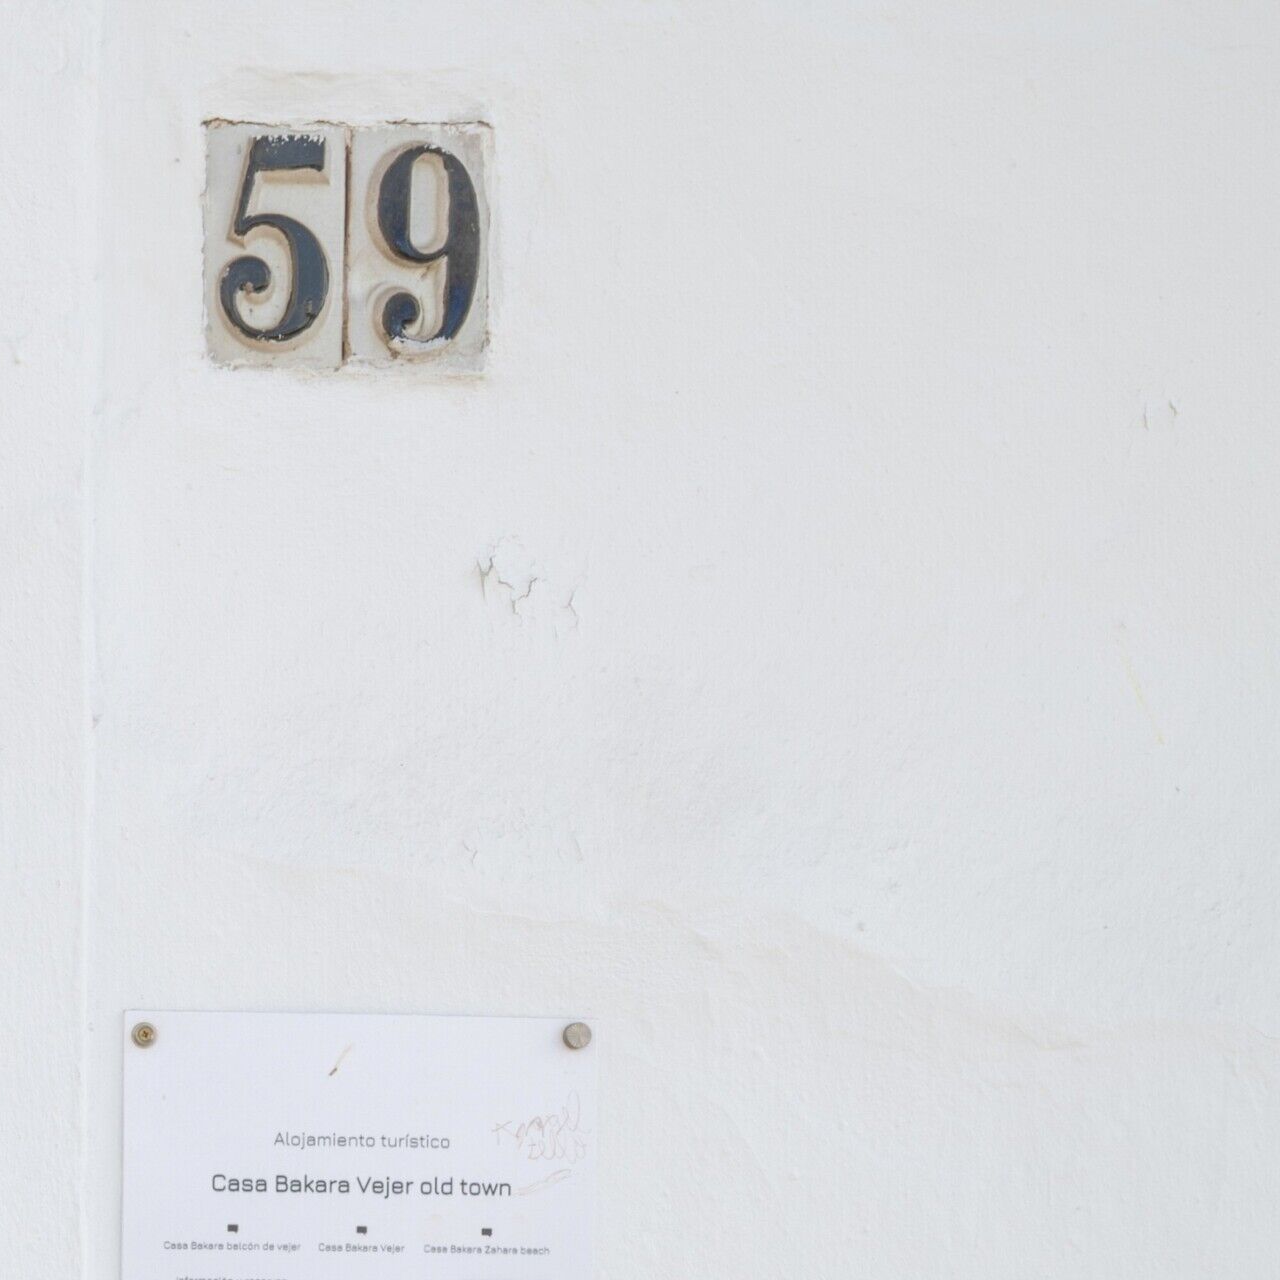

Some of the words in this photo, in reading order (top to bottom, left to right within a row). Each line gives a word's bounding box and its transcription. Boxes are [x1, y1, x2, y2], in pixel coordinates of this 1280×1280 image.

[219, 134, 481, 345] 59
[273, 1131, 376, 1151] Alojamiento
[380, 1133, 451, 1150] turístico
[211, 1173, 268, 1193] Casa
[275, 1174, 351, 1194] Bakara
[356, 1176, 415, 1200] Vejer
[420, 1176, 454, 1196] old
[459, 1179, 512, 1197] town
[163, 1240, 189, 1251] Casa
[190, 1240, 225, 1251] Bakara
[262, 1241, 275, 1252] de
[318, 1242, 344, 1253] Casa
[344, 1242, 379, 1253] Bakara
[379, 1243, 406, 1255] Vejer
[423, 1243, 449, 1254] Casa
[449, 1244, 483, 1255] Bakara
[484, 1244, 519, 1255] Zahara
[519, 1244, 551, 1257] beach
